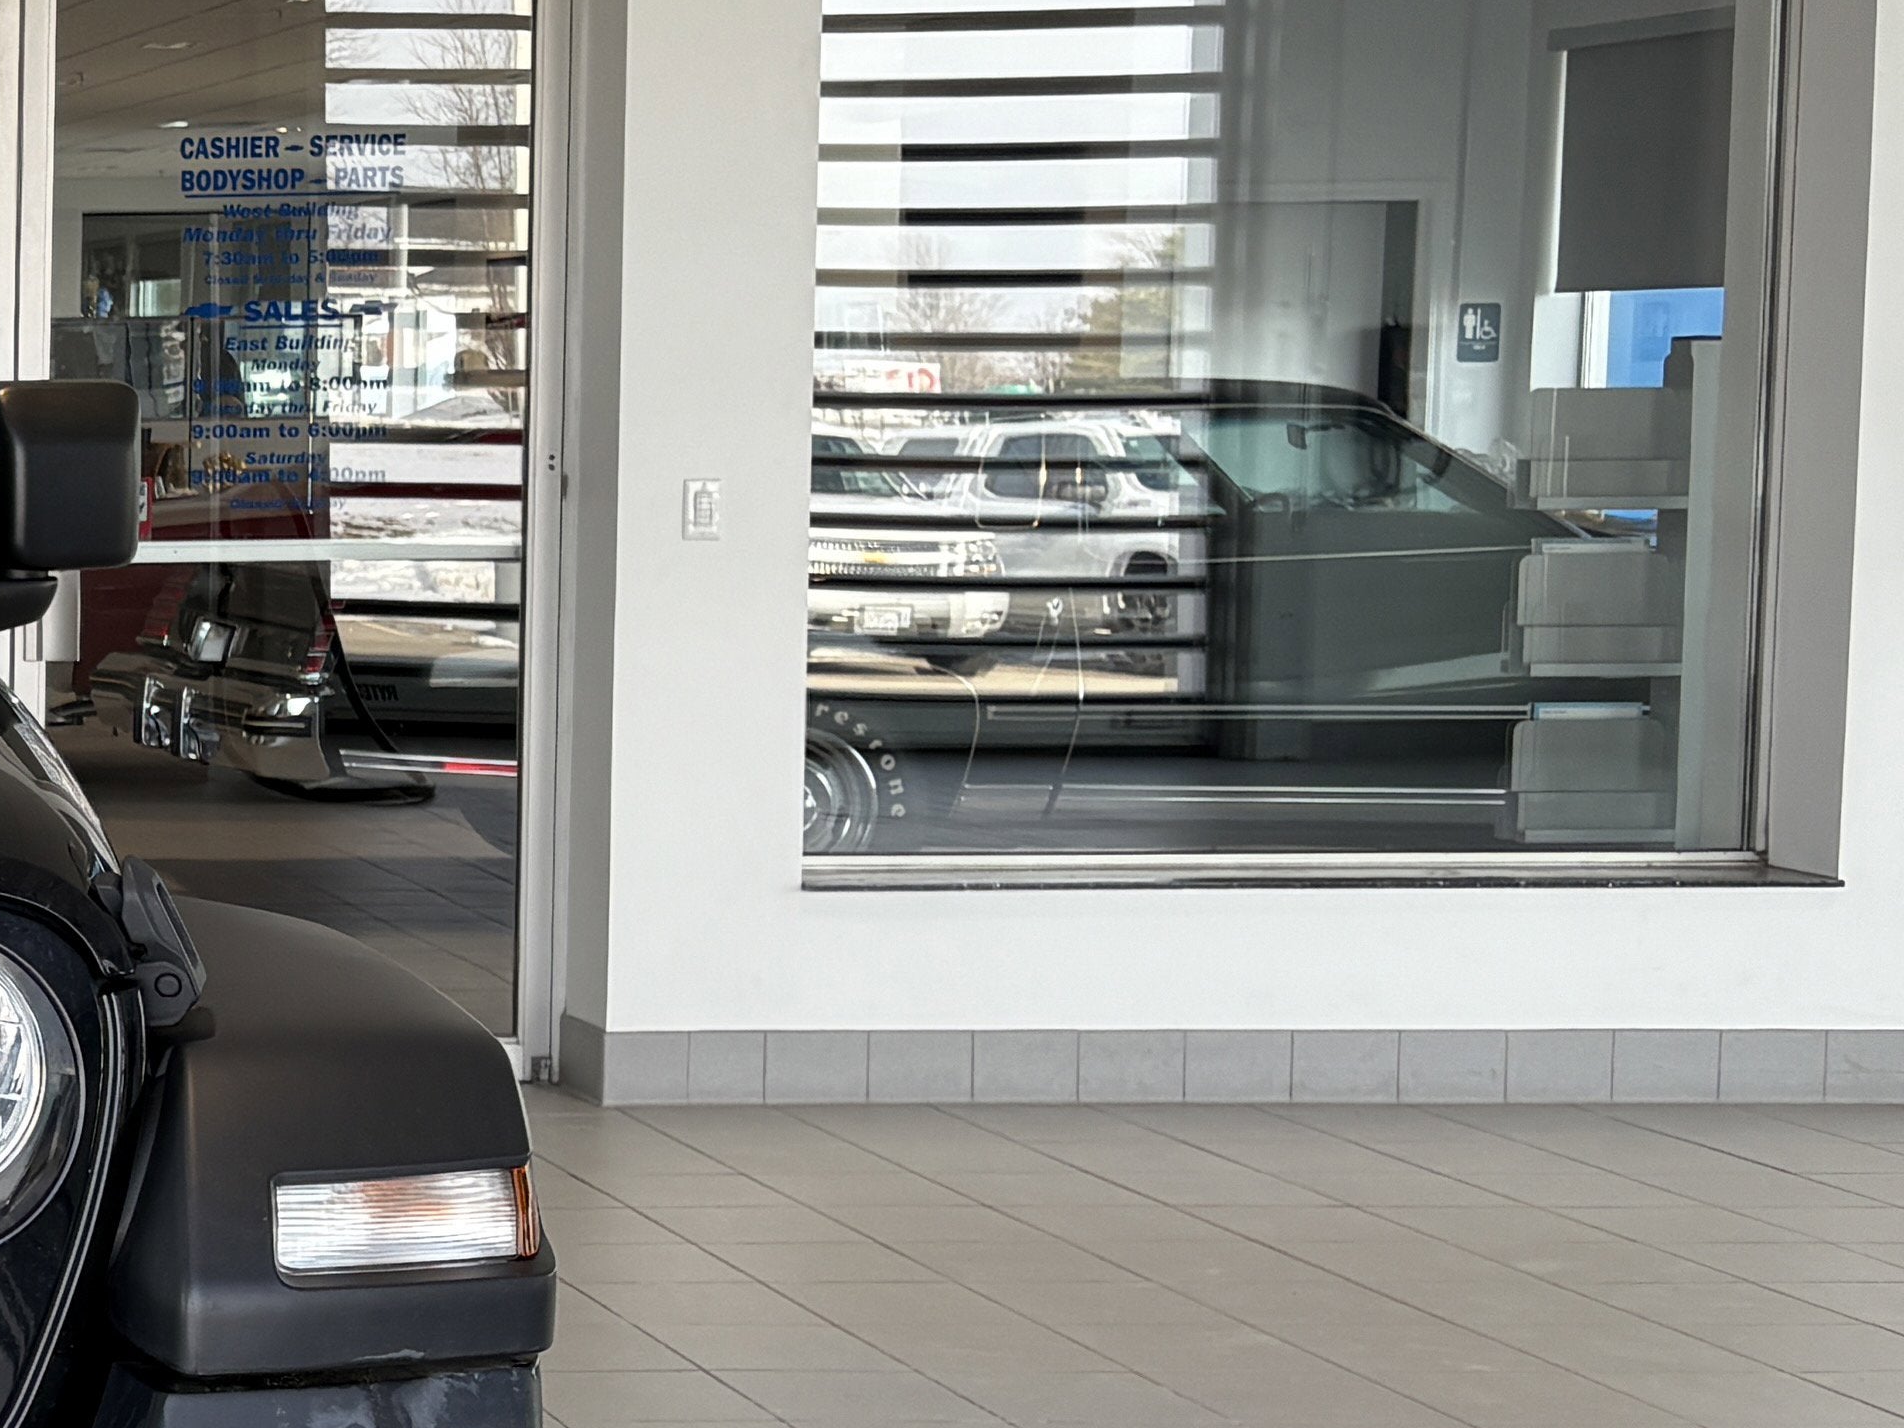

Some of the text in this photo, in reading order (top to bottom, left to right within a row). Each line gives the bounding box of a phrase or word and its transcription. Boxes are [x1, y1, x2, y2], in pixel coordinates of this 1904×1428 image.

[180, 133, 406, 159] CASHIER SERVICE
[181, 165, 404, 192] BODYSHOP PARTS
[223, 202, 360, 221] West Building
[182, 222, 392, 245] Monday thru Friday
[244, 298, 341, 322] SALES
[225, 335, 356, 352] East Building
[251, 359, 320, 373] Monday
[193, 422, 387, 440] 9:00am to 6:00pm
[245, 452, 326, 465] Saturday
[278, 470, 299, 483] to
